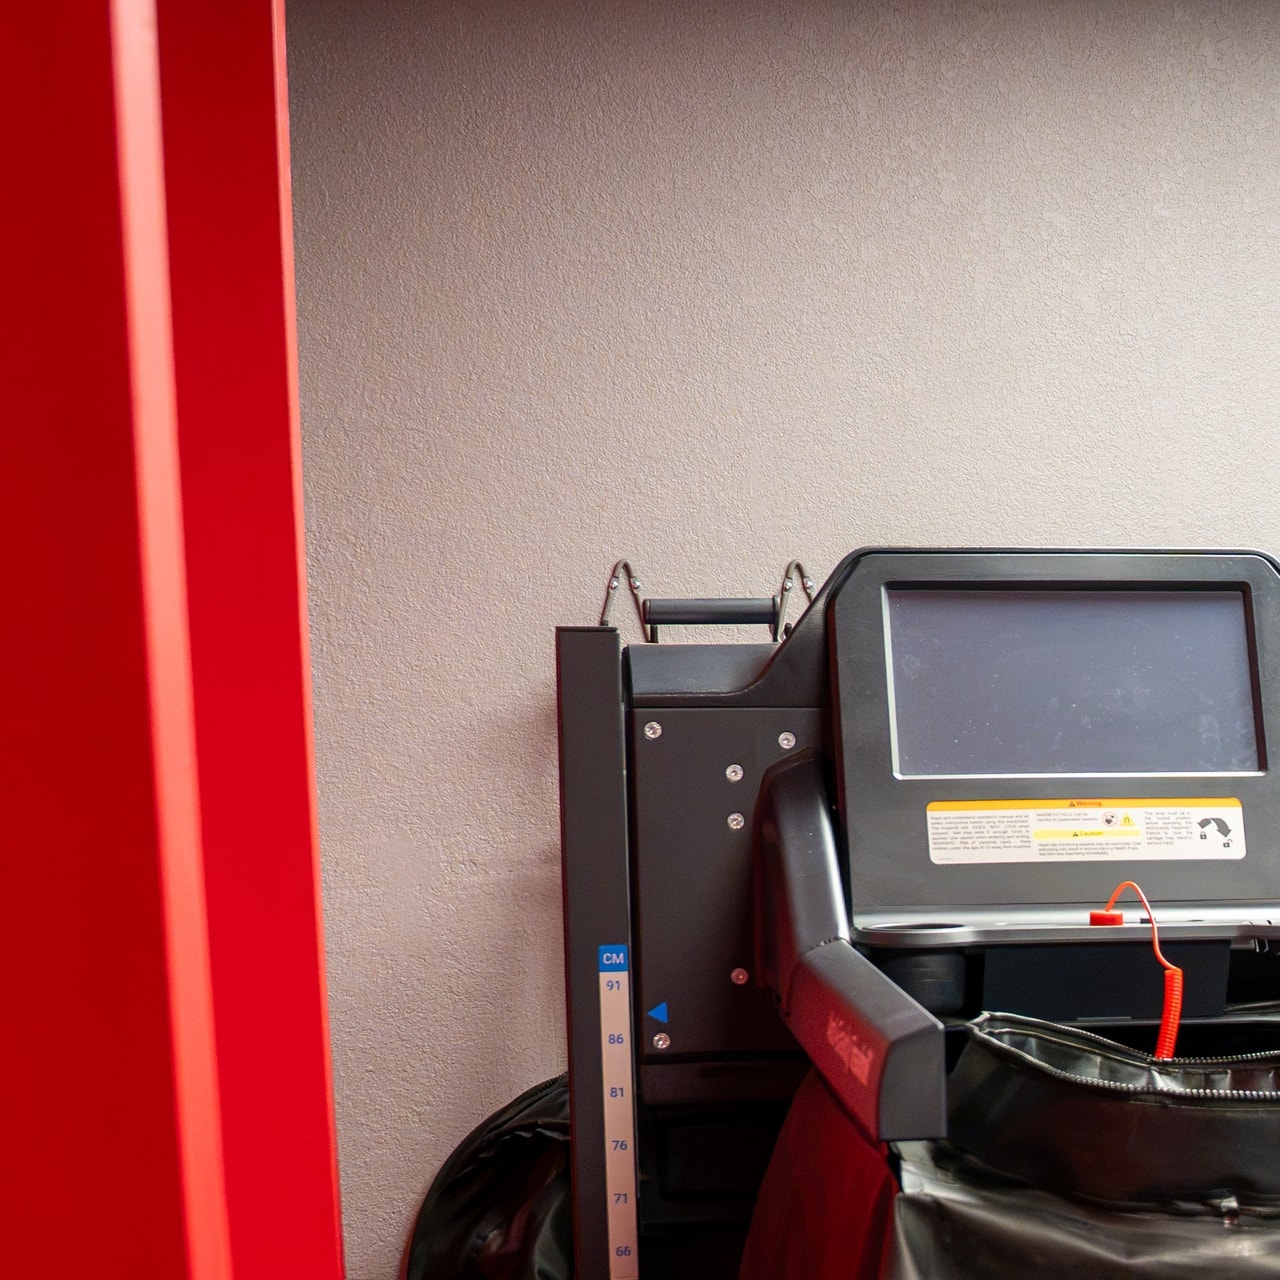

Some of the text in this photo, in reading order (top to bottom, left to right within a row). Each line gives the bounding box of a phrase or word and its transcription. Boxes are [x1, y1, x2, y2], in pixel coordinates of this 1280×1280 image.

[603, 953, 624, 964] CM
[606, 980, 621, 991] 91
[608, 1034, 624, 1045] 86
[610, 1087, 624, 1098] 81
[612, 1140, 628, 1151] 76
[614, 1193, 628, 1204] 71
[615, 1246, 632, 1257] 66
